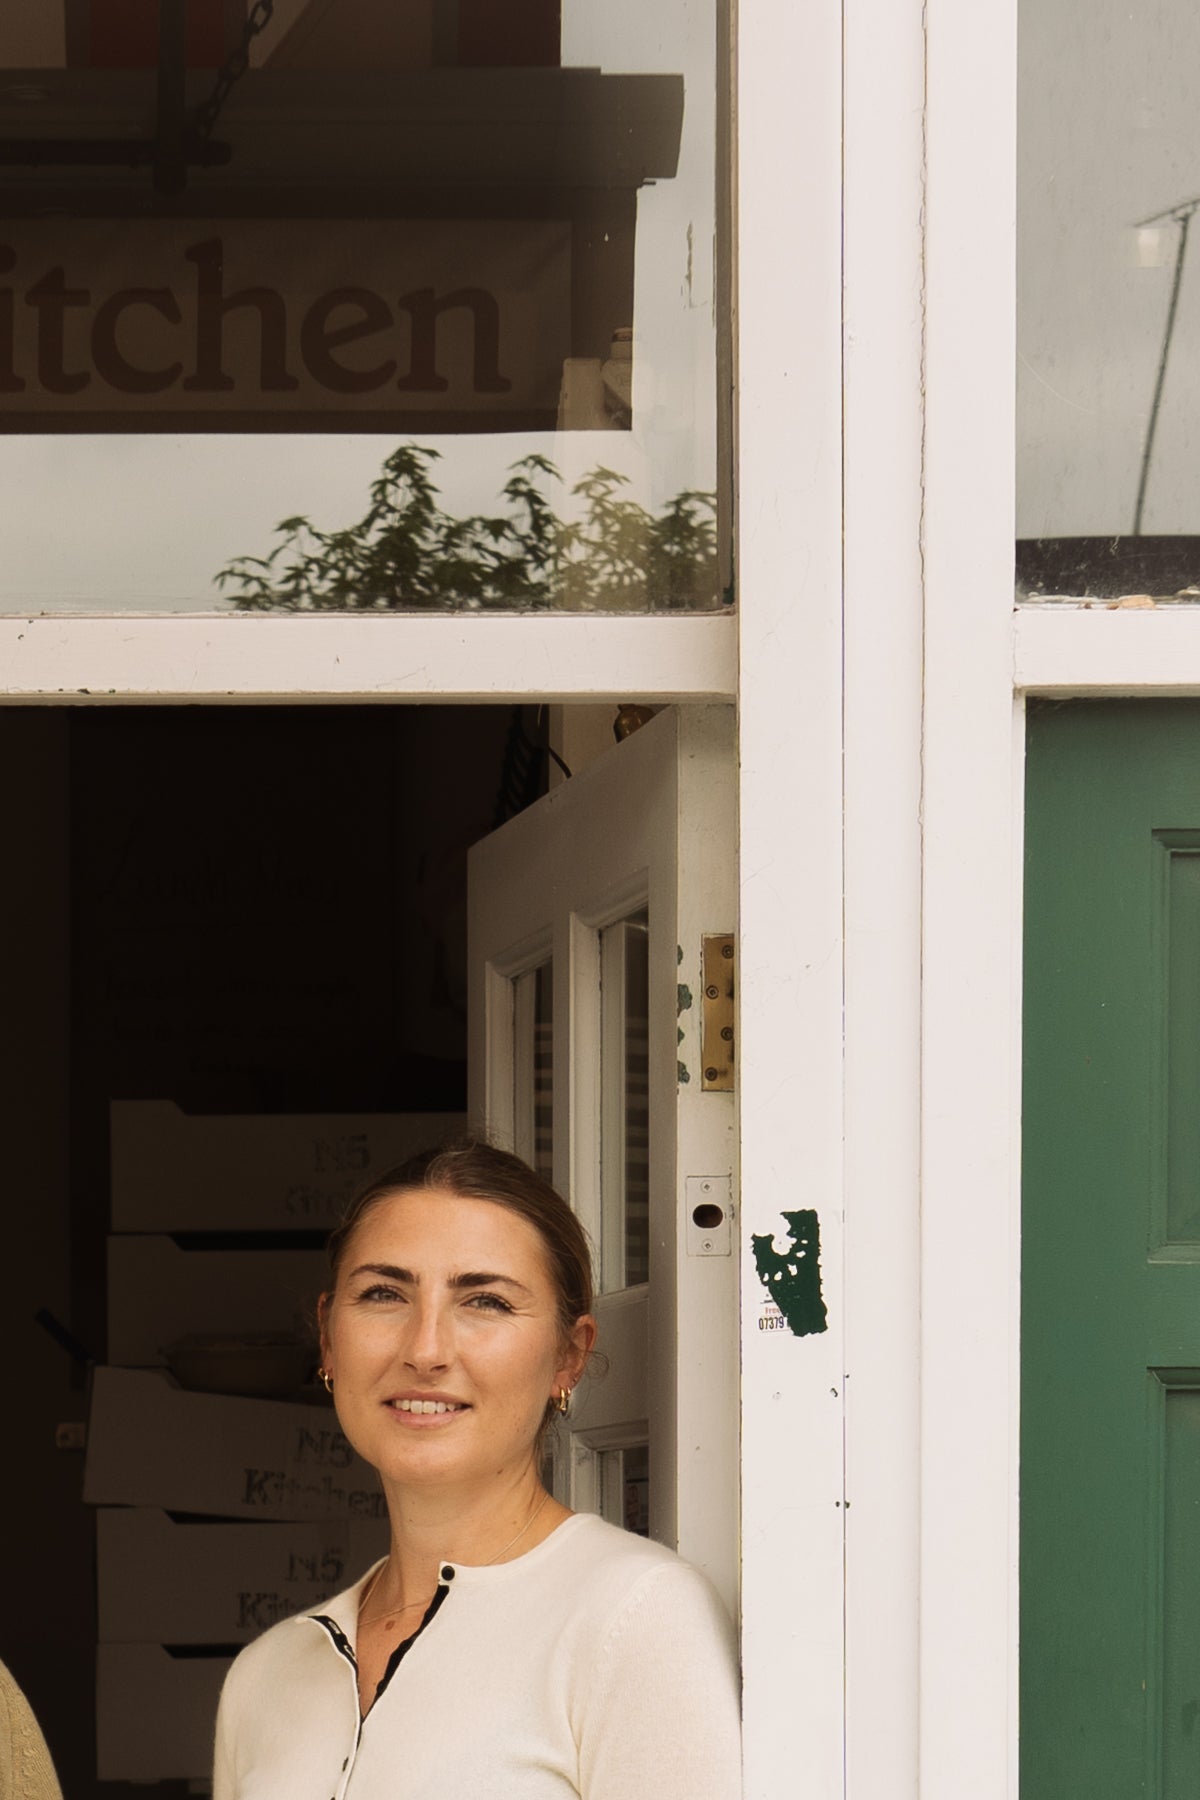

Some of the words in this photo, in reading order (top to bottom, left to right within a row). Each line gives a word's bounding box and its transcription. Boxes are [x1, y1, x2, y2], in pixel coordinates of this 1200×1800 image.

[758, 1316, 785, 1330] 07379
[294, 1427, 354, 1469] N5
[285, 1546, 345, 1584] N5
